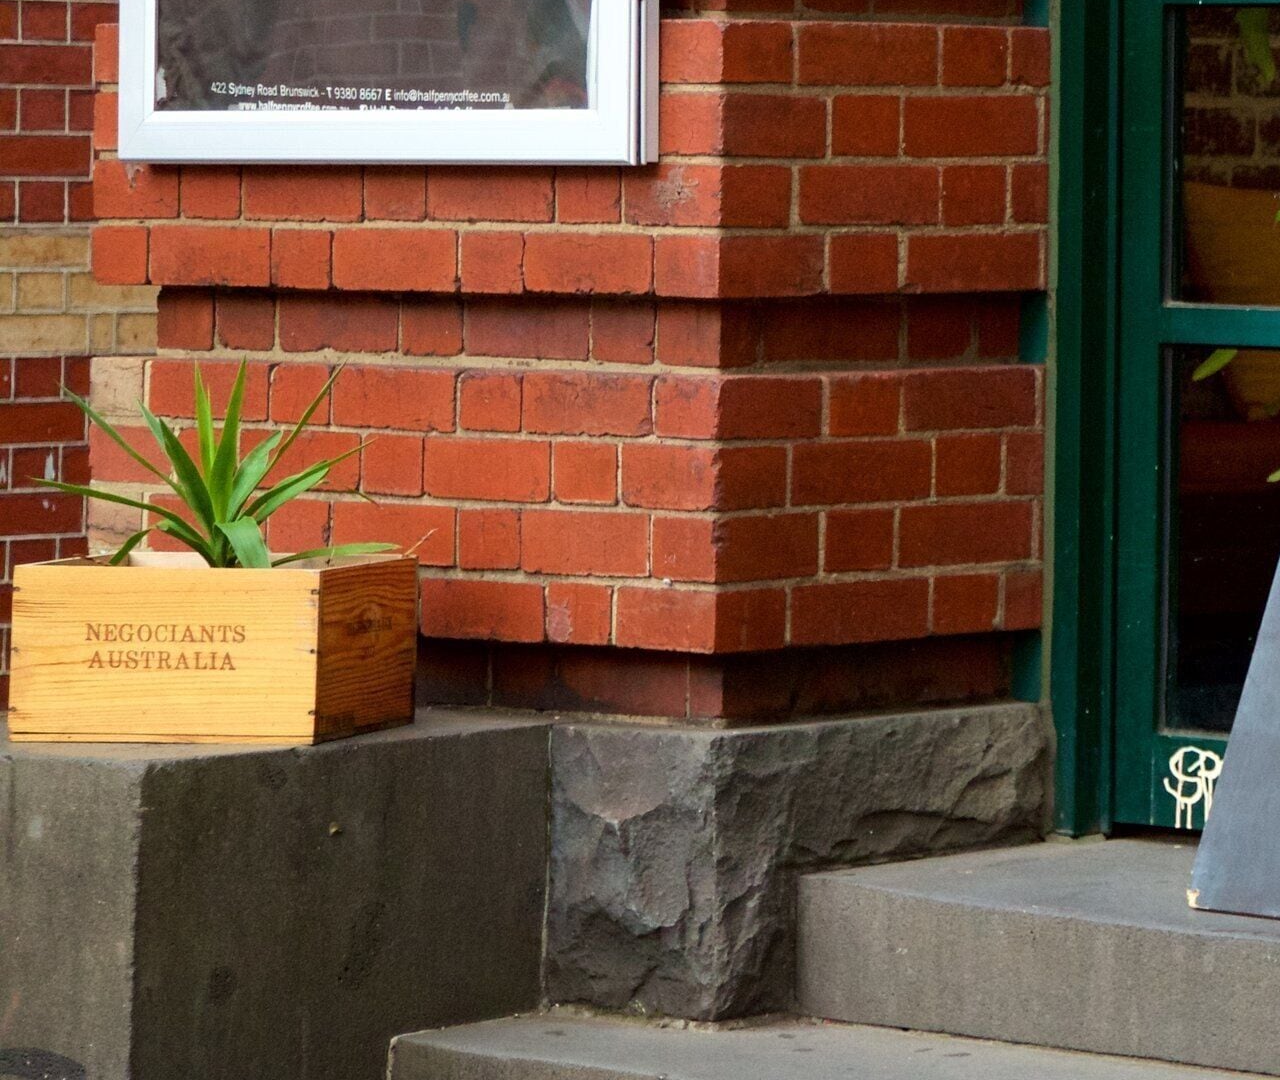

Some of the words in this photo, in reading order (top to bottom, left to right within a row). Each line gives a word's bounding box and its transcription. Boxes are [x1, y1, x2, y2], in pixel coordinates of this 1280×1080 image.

[211, 82, 227, 94] 422
[228, 82, 256, 97] Sydney
[257, 83, 278, 96] Road
[279, 84, 320, 98] Brunswick
[326, 87, 333, 99] T
[334, 87, 358, 100] 9380
[359, 87, 382, 101] 8667
[385, 88, 392, 101] E
[85, 623, 247, 644] NEGOCIANTS
[88, 650, 236, 671] AUSTRALIA
